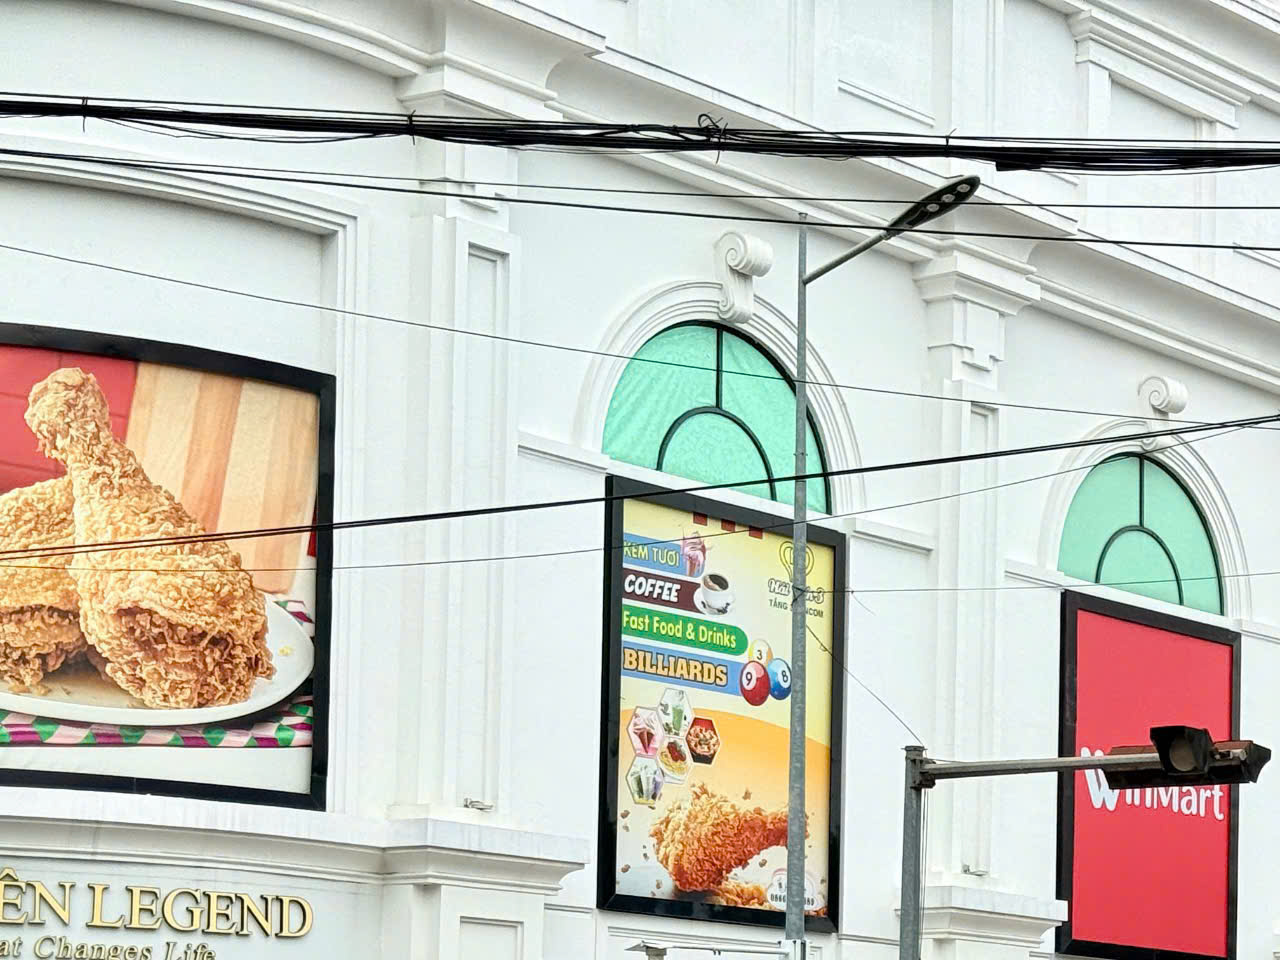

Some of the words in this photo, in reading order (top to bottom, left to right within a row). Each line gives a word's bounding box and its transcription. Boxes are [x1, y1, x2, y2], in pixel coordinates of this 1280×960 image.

[624, 574, 681, 603] COFFEE
[623, 610, 650, 632] Fast
[653, 616, 683, 638] Food
[686, 622, 695, 641] &
[699, 625, 737, 649] Drinks
[623, 646, 728, 688] BILLIARDS
[756, 649, 763, 661] 3
[745, 672, 753, 686] 9
[781, 670, 789, 684] 8
[87, 883, 314, 939] LEGEND
